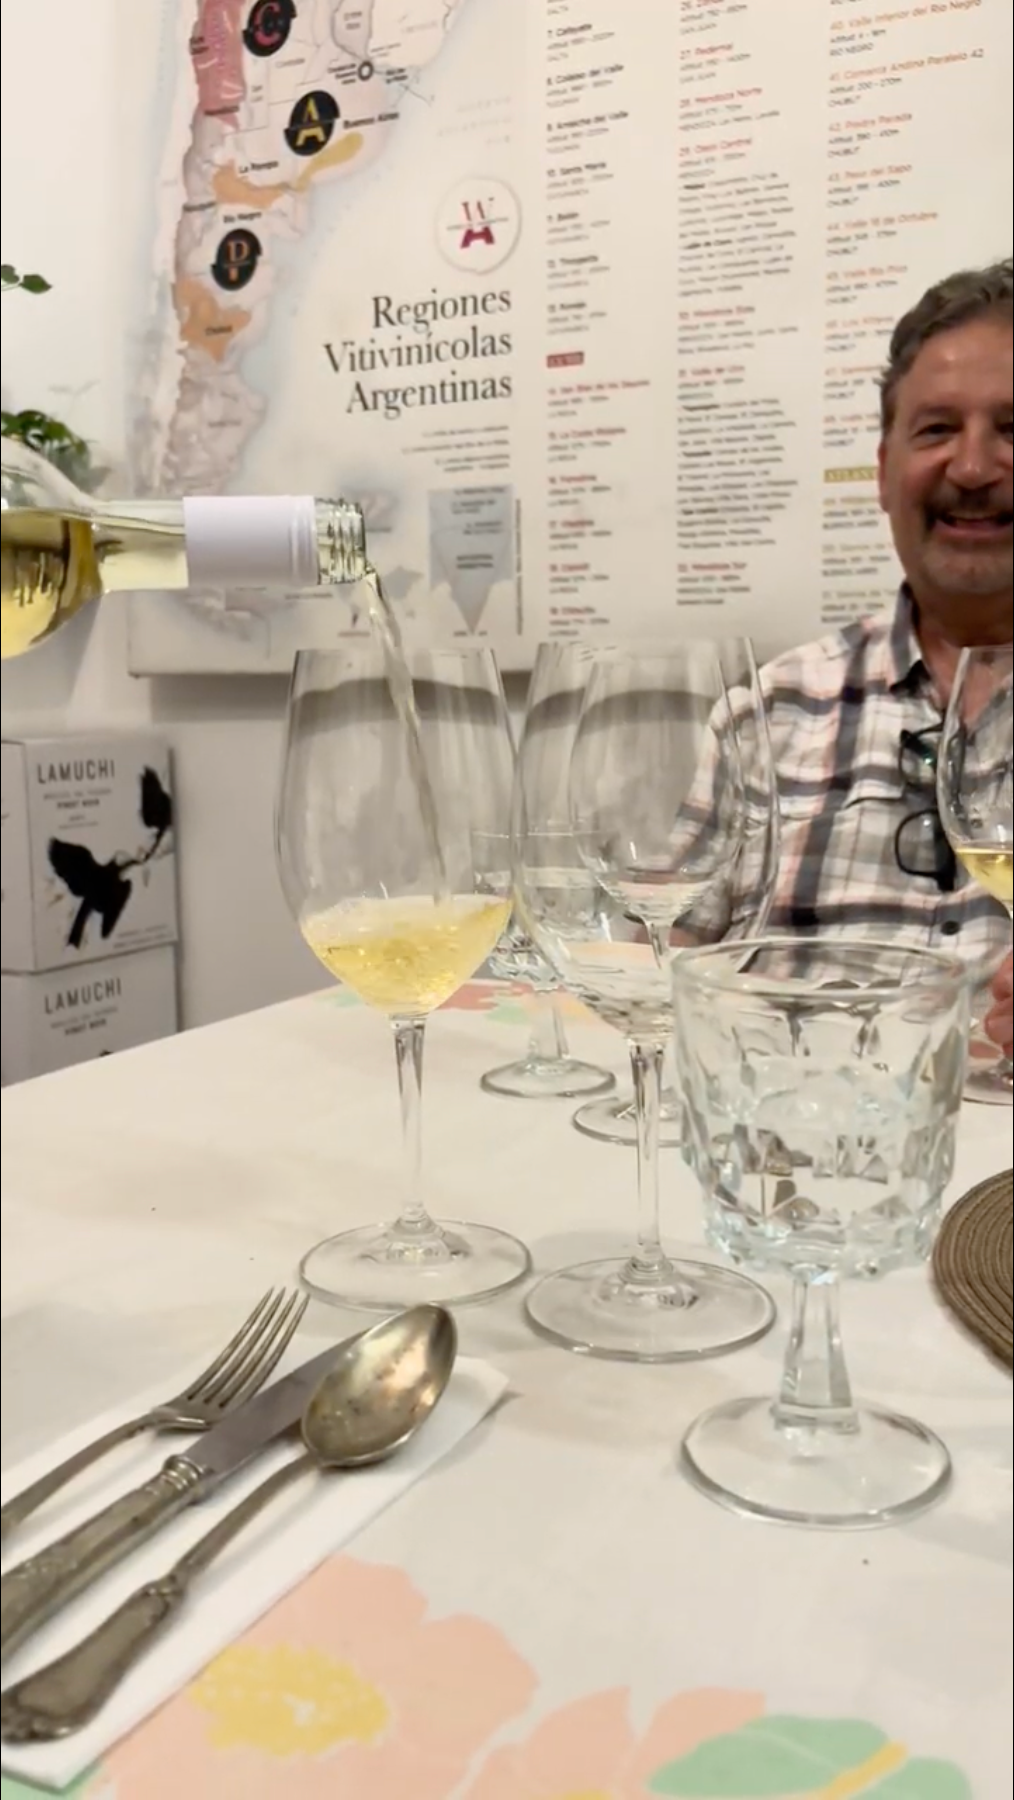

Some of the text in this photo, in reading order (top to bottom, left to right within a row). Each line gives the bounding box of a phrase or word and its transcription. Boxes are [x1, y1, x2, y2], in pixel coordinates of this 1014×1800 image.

[971, 48, 984, 58] 42
[296, 96, 326, 146] A
[372, 288, 512, 333] Regiones
[323, 325, 512, 374] Vitivinícolas
[346, 370, 512, 420] Argentinas
[37, 759, 115, 784] LAMUCHI
[44, 977, 121, 1015] LAMUCHI
